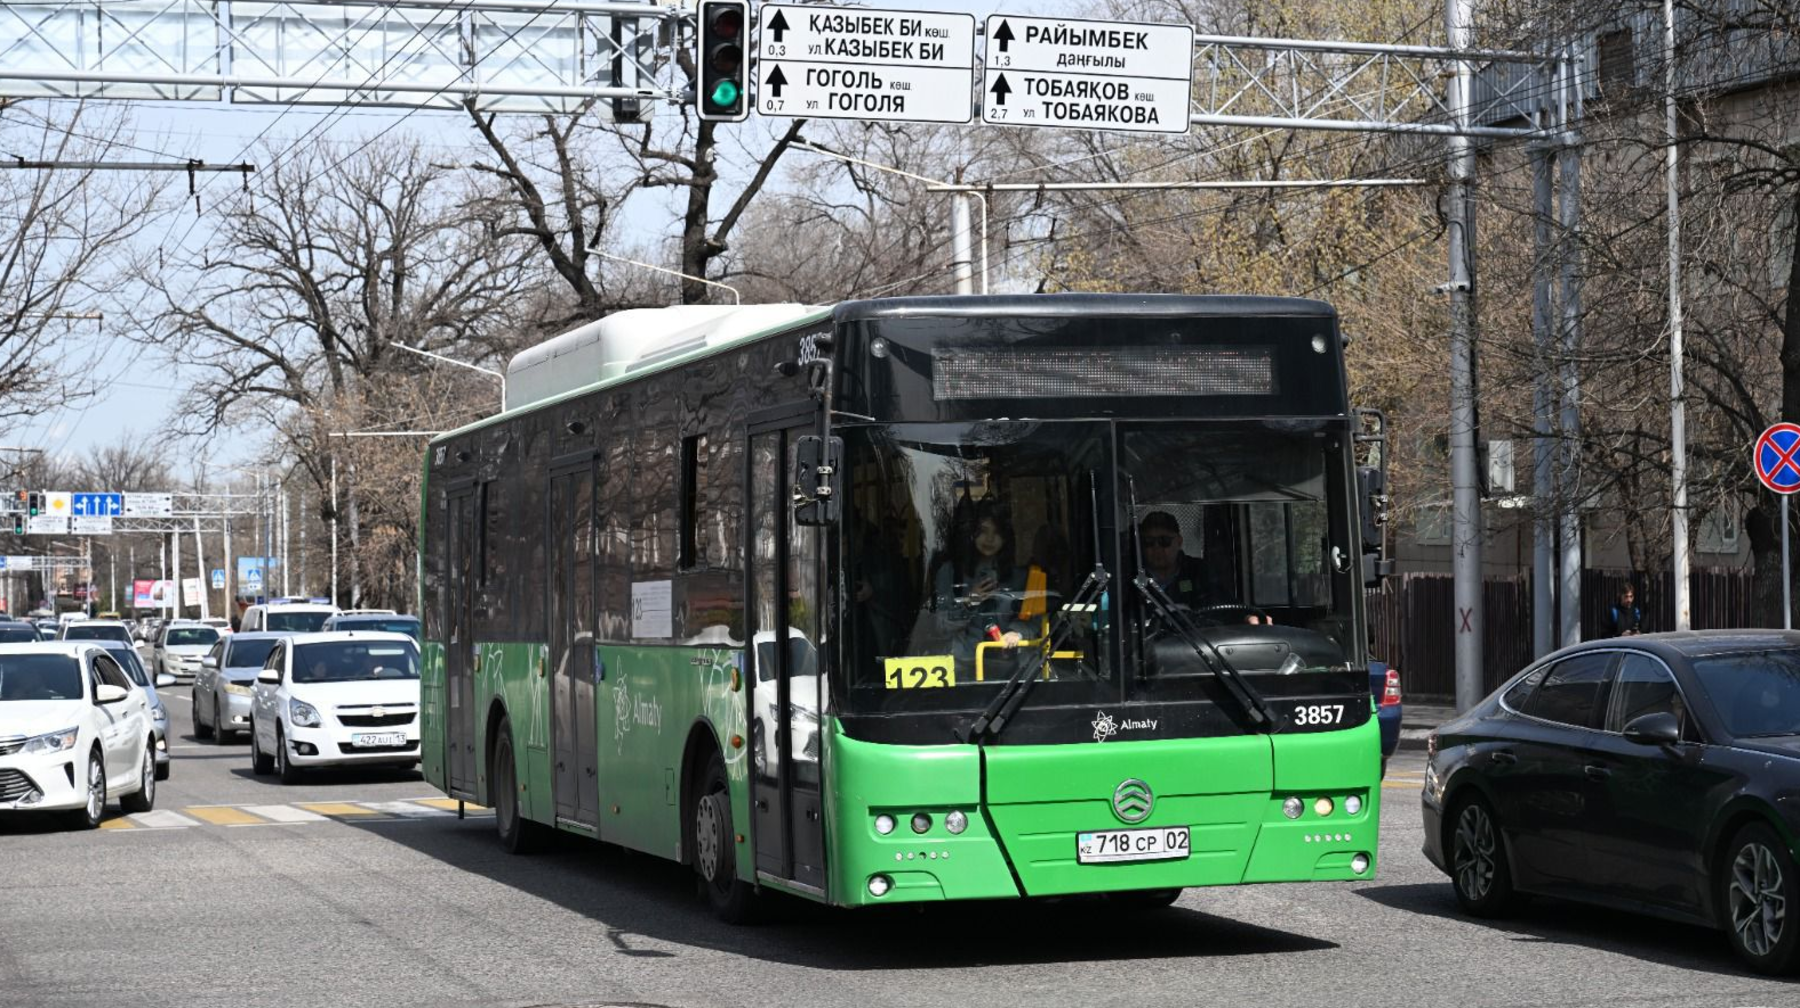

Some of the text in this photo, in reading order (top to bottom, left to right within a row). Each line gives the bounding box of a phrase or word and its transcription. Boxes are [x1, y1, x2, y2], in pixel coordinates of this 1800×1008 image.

[809, 14, 894, 36] ҚАЗЫБЕК
[900, 19, 922, 37] БИ
[1025, 24, 1149, 50] РАЙЫМБЕК
[768, 45, 786, 57] 0,3
[825, 38, 914, 59] КАЗЫБЕК
[919, 43, 944, 61] БИ
[995, 56, 1011, 68] 1,3
[1057, 53, 1126, 69] даңғылы
[806, 68, 883, 90] ГОГОЛЬ
[1024, 78, 1130, 102] ТОБАЯҚОВ
[766, 100, 785, 113] 0,7
[828, 92, 905, 113] ГОГОЛЯ
[1042, 101, 1160, 124] ТОБАЯКОВА
[991, 108, 1008, 120] 2,7
[889, 666, 950, 688] 123
[633, 692, 662, 736] Almaty
[1120, 719, 1158, 731] Almaty
[1294, 704, 1344, 725] 3857
[1096, 834, 1130, 853] 718
[1136, 836, 1157, 851] CP
[1166, 831, 1188, 849] 02
